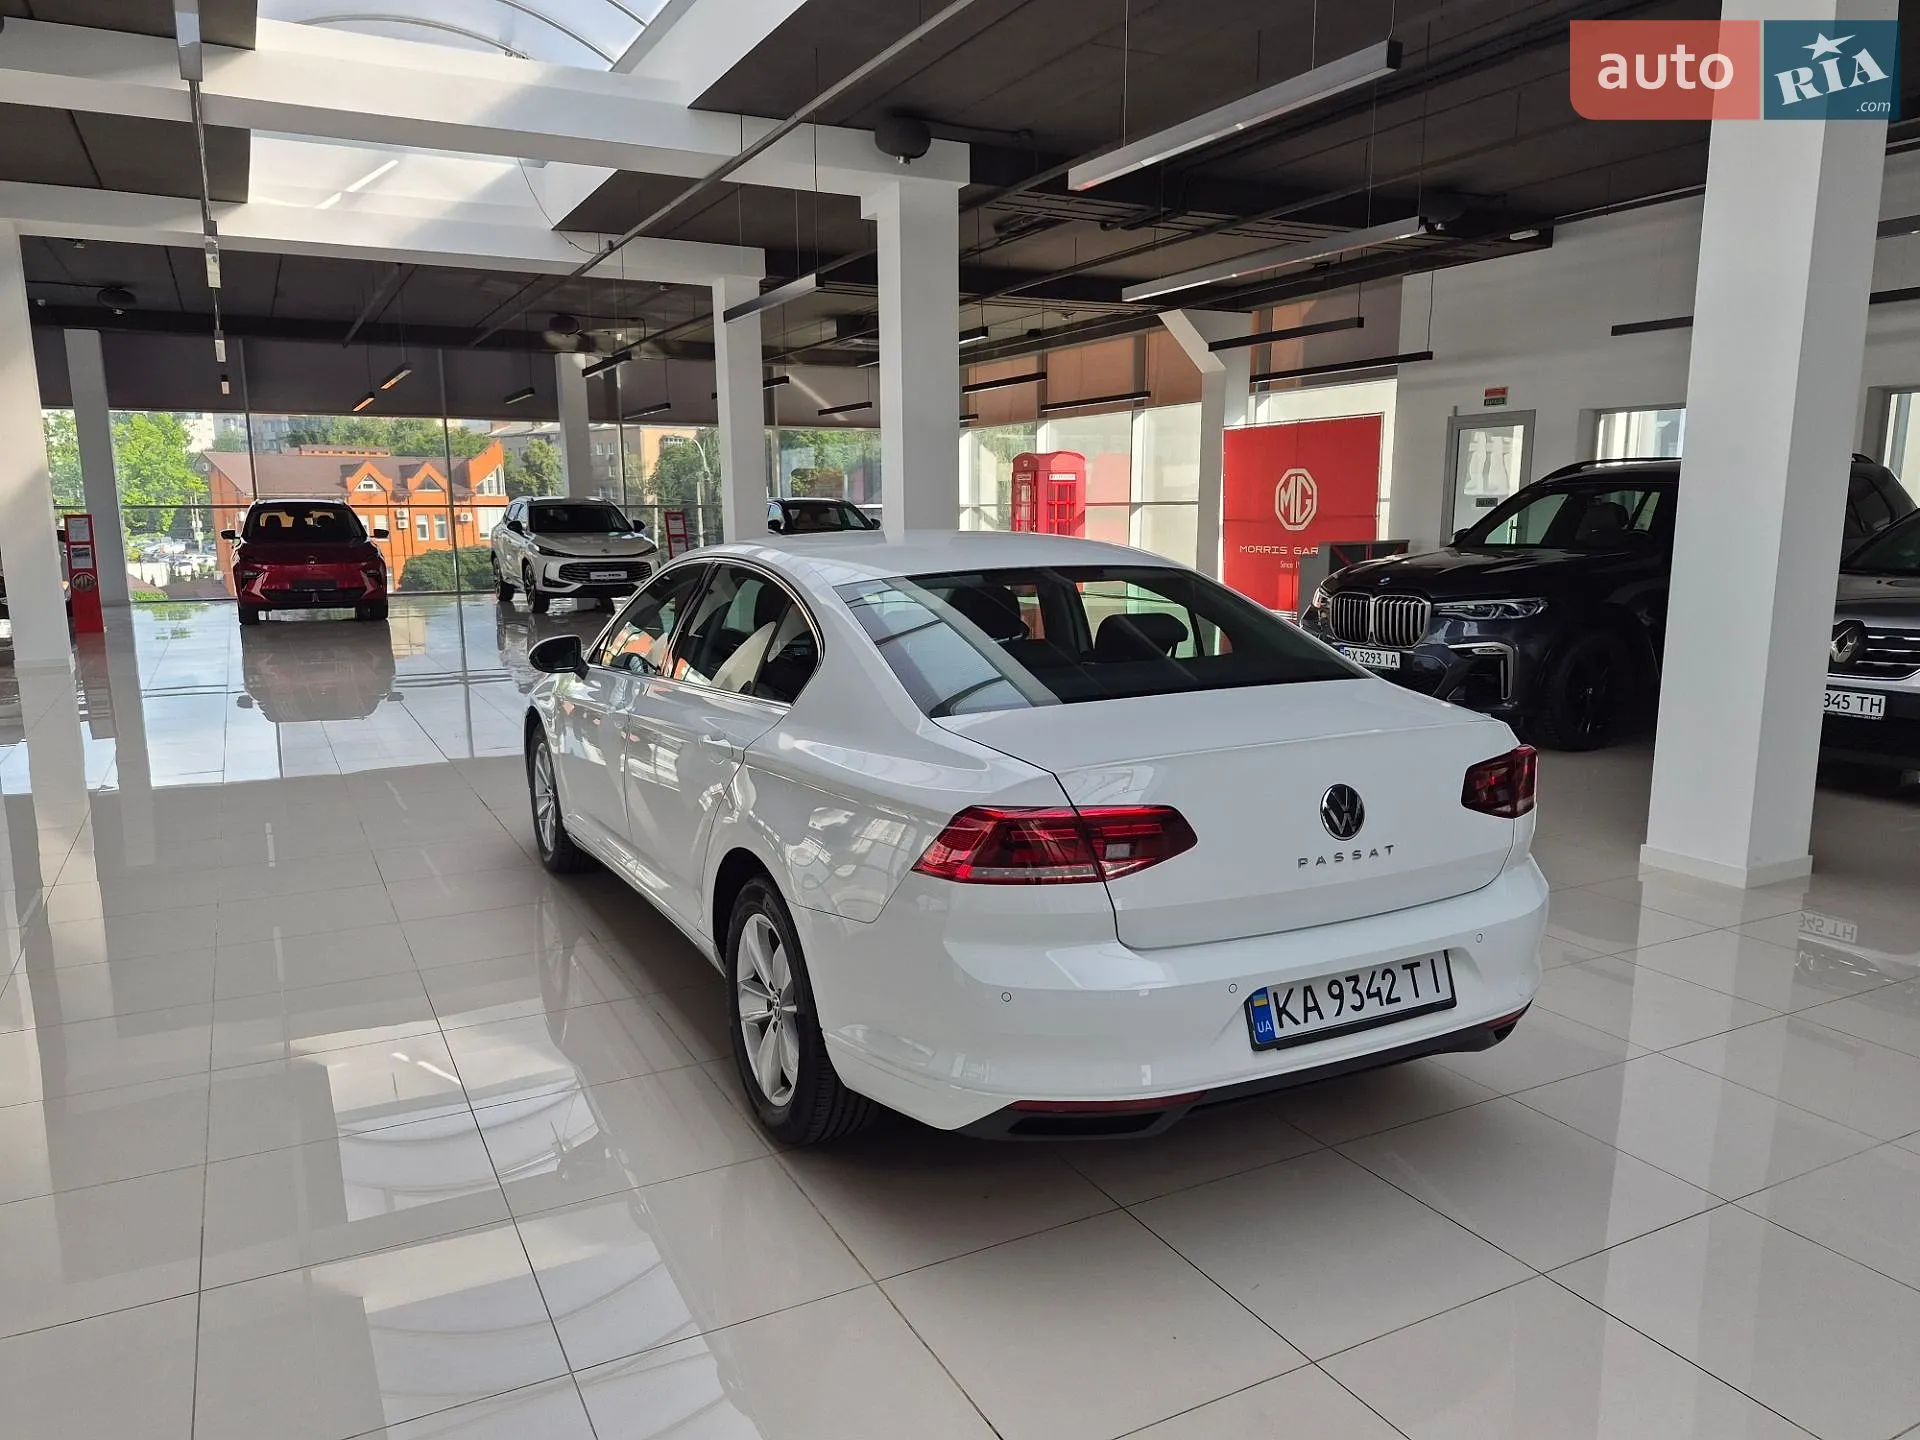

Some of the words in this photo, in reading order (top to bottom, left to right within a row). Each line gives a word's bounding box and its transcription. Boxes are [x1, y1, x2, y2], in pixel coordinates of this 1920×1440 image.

[1279, 472, 1314, 526] MG
[1239, 545, 1288, 555] MORRIS
[1293, 546, 1319, 555] GAR
[1359, 651, 1382, 664] 5293
[1856, 695, 1882, 713] TH
[1297, 844, 1394, 869] PASSAT
[1272, 984, 1324, 1029] KA
[1327, 967, 1402, 1018] 9342
[1256, 1021, 1273, 1034] UA
